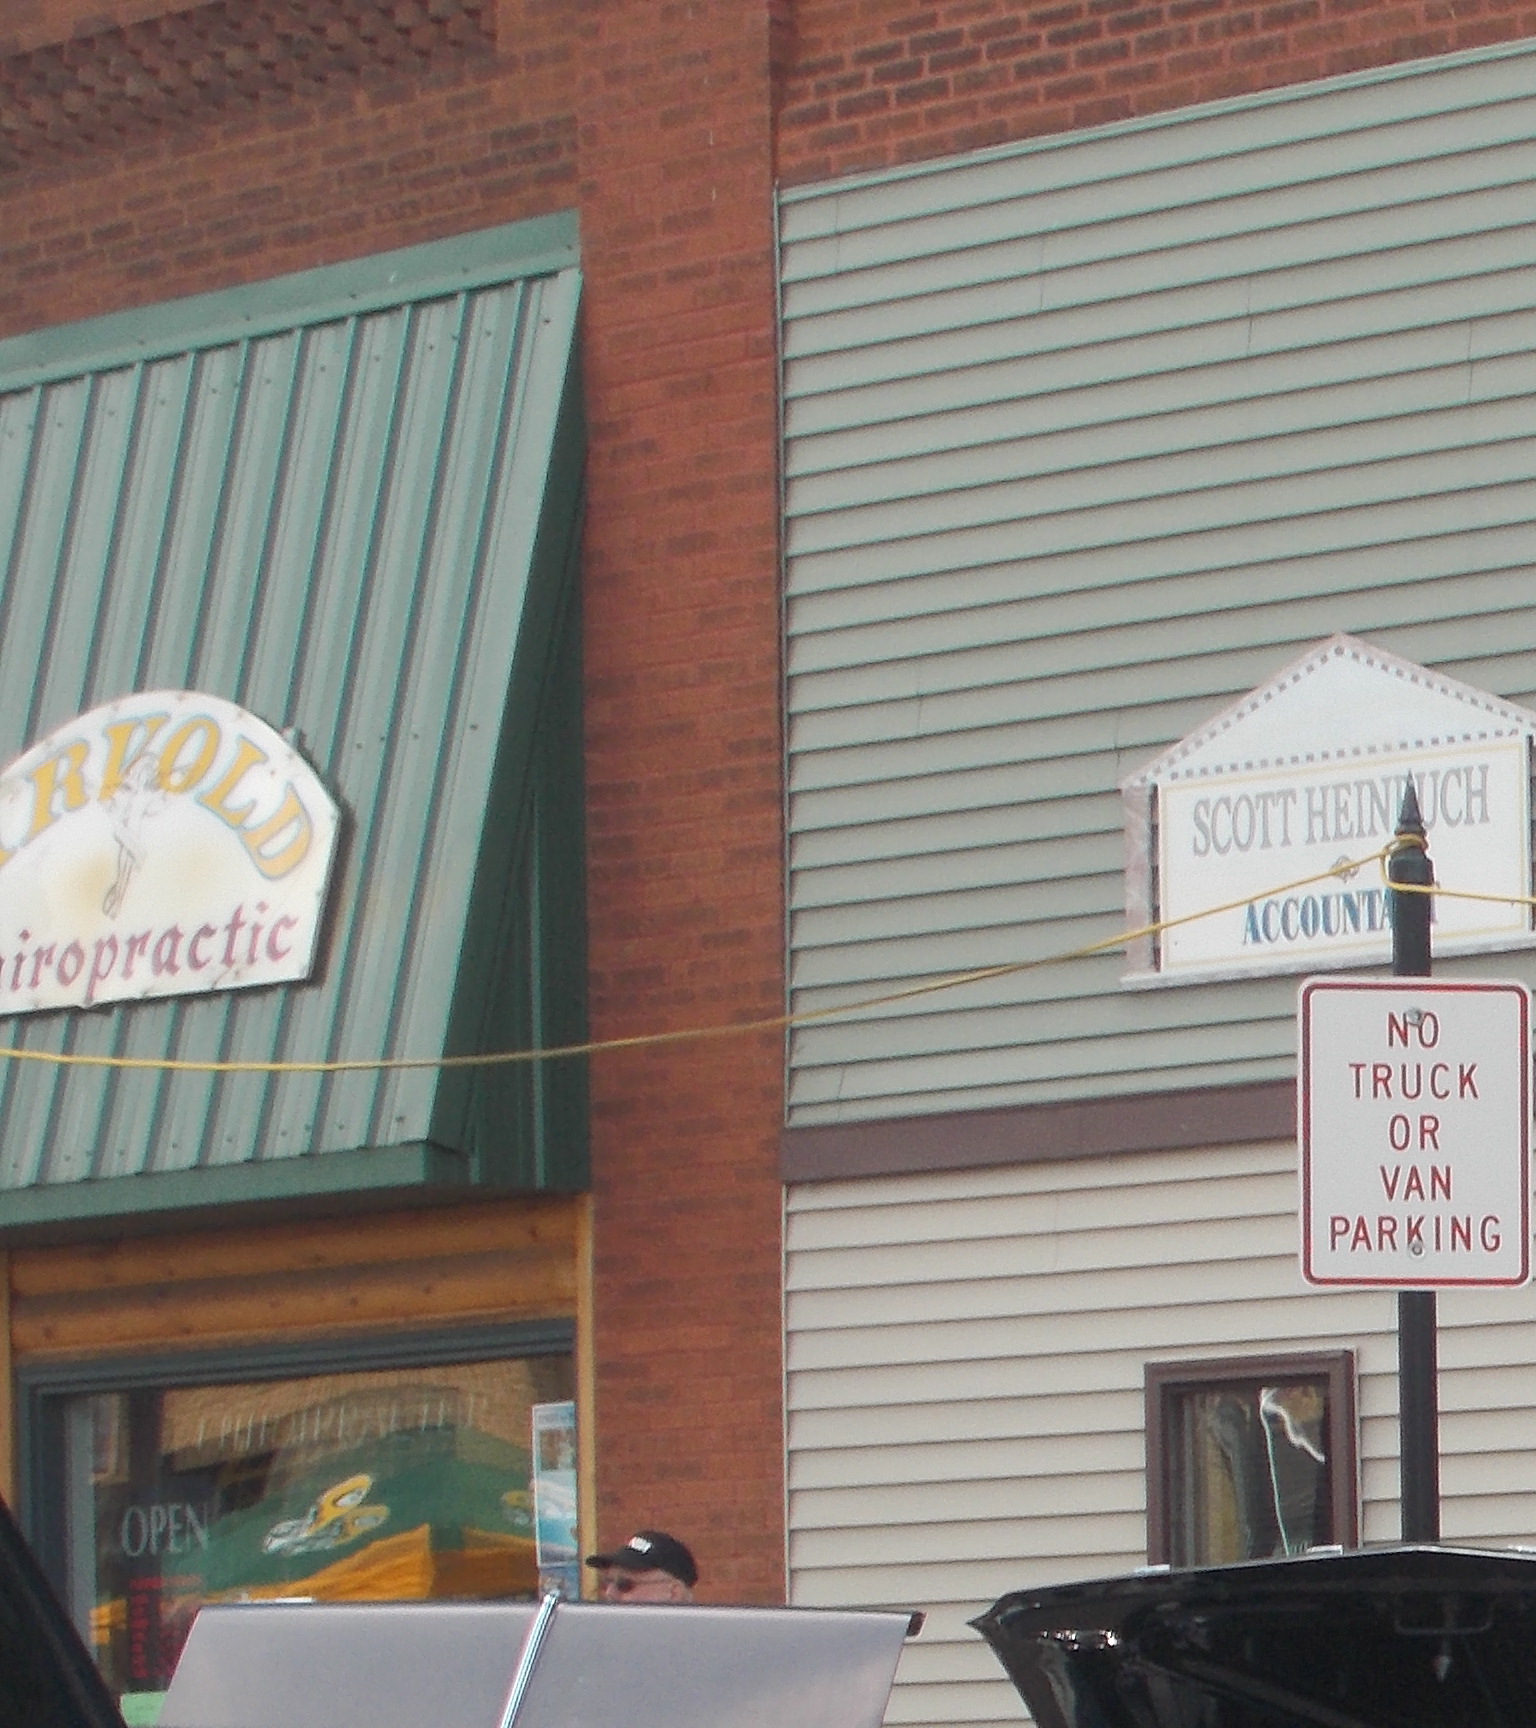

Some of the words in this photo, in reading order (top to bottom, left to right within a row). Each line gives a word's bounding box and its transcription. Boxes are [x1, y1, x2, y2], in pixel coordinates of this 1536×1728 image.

[0, 714, 313, 881] RVOLD
[1192, 783, 1296, 857] SCOTT
[1242, 880, 1438, 946] ACCOUNTA
[0, 900, 299, 1003] iropractic
[1387, 1012, 1440, 1049] NO
[1348, 1063, 1480, 1100] TRUCK
[1388, 1114, 1440, 1150] OR
[1379, 1165, 1452, 1201] VAN
[1329, 1214, 1501, 1252] PARKING
[120, 1501, 209, 1558] OPEN
